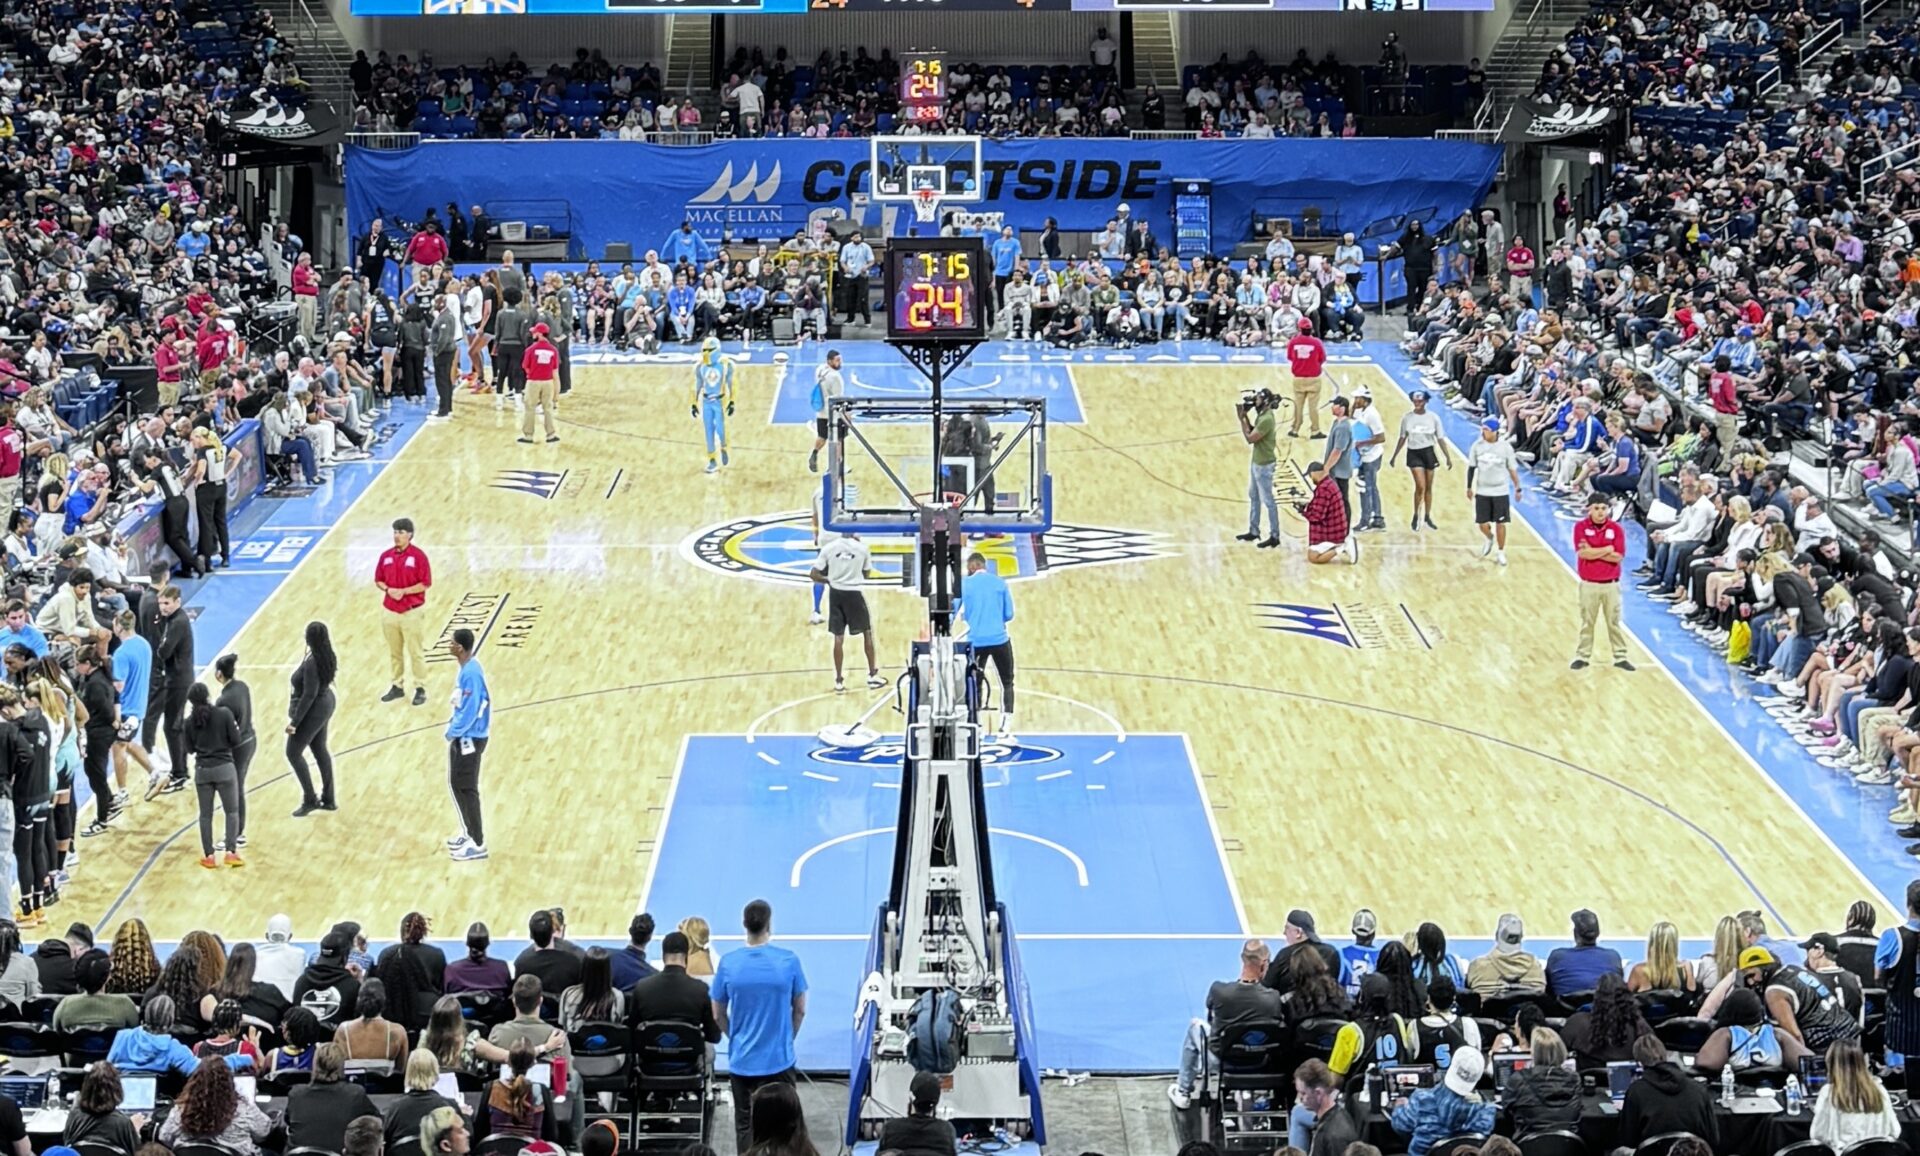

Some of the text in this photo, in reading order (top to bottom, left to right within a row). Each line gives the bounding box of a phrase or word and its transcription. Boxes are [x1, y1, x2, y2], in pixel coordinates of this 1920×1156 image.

[911, 75, 938, 98] 24
[803, 159, 1162, 202] CORTSIDE
[918, 253, 970, 279] 7:15
[910, 283, 963, 328] 24
[423, 592, 499, 663] WNTRUST
[496, 605, 543, 648] ARENA
[1376, 1034, 1397, 1060] 10
[1434, 1043, 1451, 1068] 5
